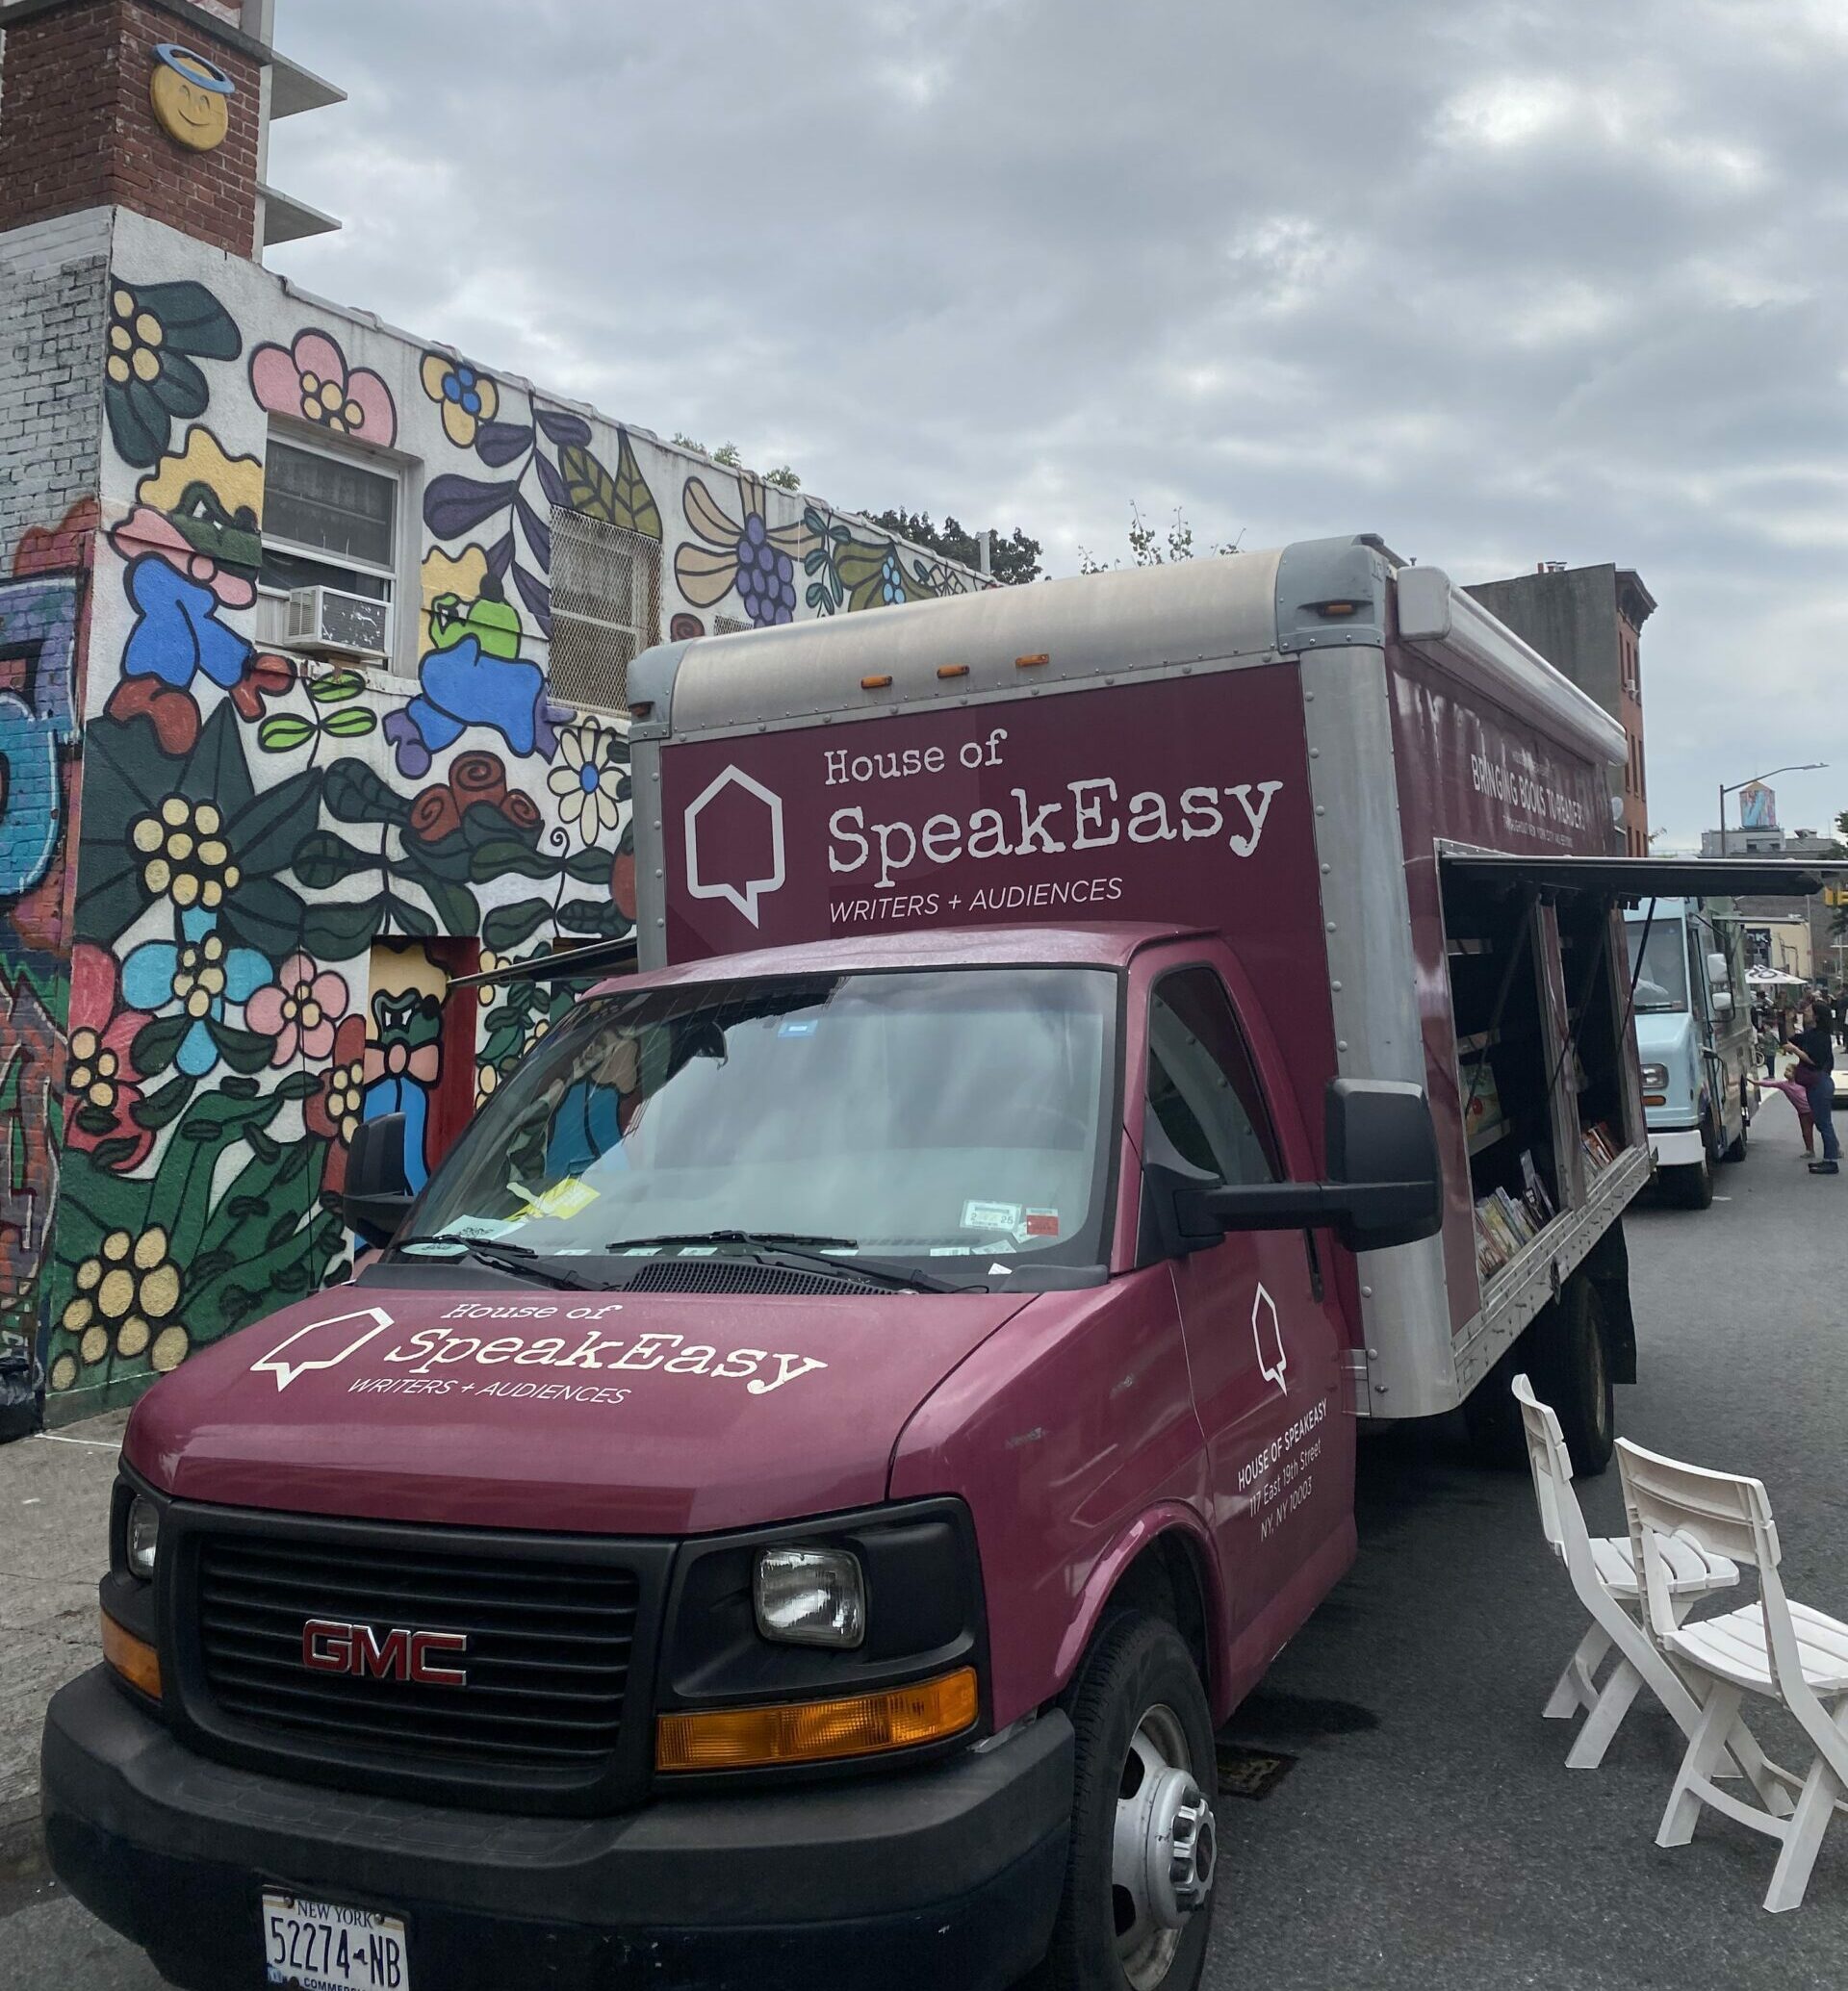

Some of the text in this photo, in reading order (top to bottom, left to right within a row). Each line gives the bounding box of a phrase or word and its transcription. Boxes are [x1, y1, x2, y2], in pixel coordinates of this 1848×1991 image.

[824, 727, 1009, 785] House of
[828, 777, 1284, 888] SpeakEasy
[829, 877, 1124, 924] WRITERS + AUDIENCES
[440, 1303, 624, 1320] House of
[347, 1378, 633, 1404] WRITERS + AUDIENCES
[383, 1328, 829, 1395] SpeakEasy
[1238, 1397, 1328, 1492] HOUSE OF SPEAKEASY
[1249, 1491, 1262, 1518] 117
[1264, 1476, 1281, 1505] East
[1299, 1438, 1322, 1471] Street
[1275, 1503, 1289, 1527] NY
[1290, 1475, 1313, 1514] 10003
[302, 1619, 468, 1687] GMC
[297, 1901, 374, 1929] NEW YORK
[270, 1916, 350, 1979] 52274
